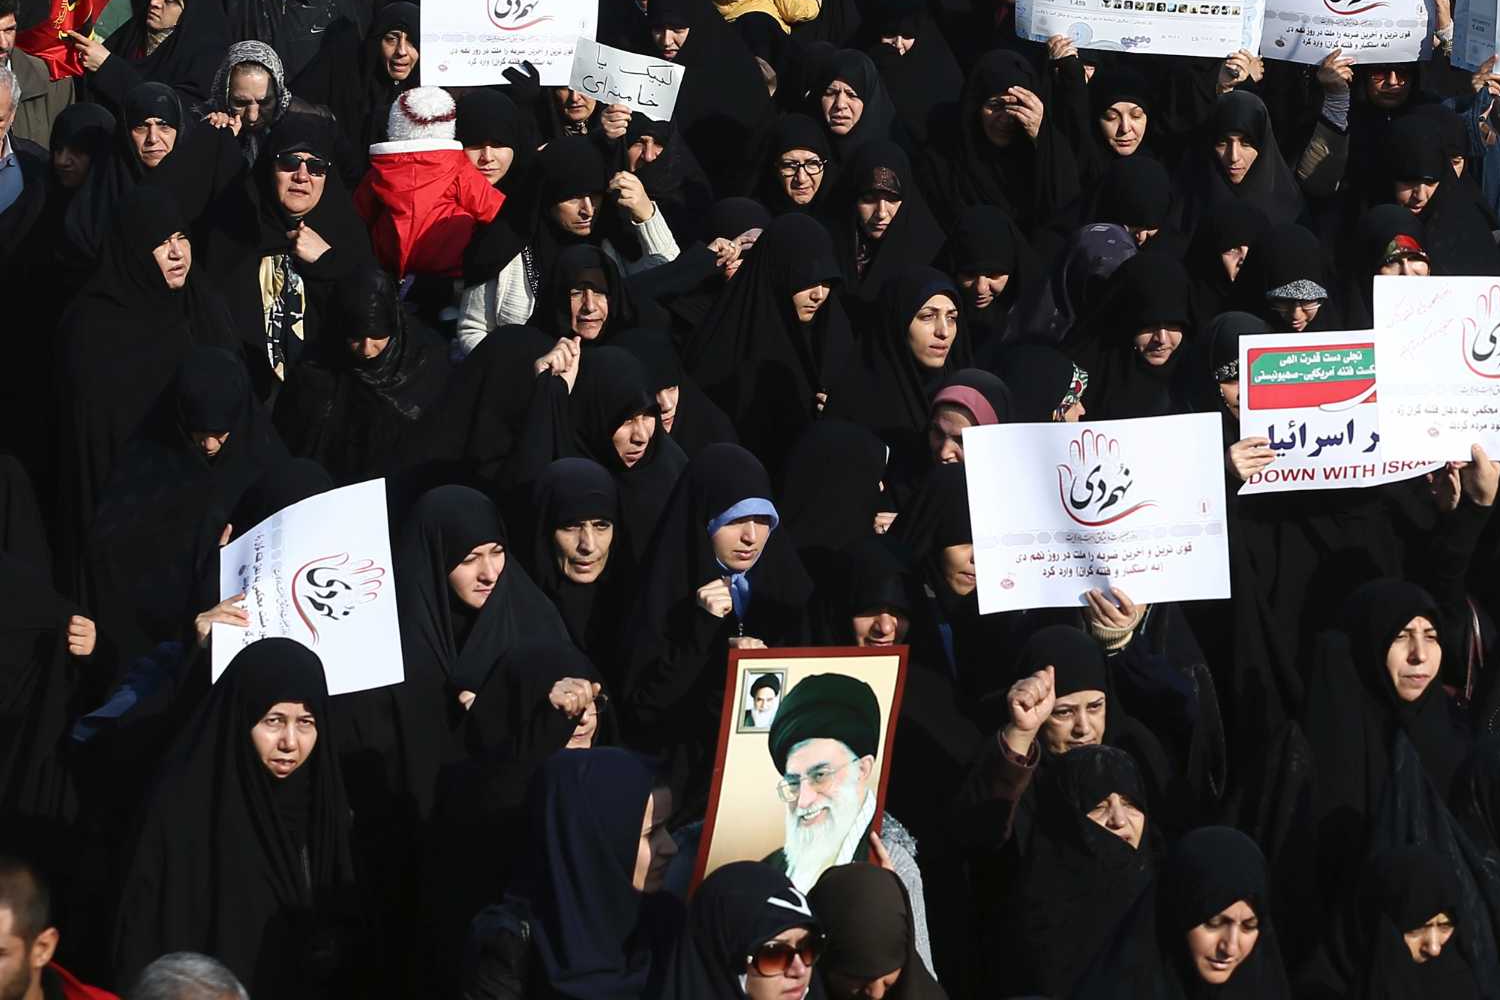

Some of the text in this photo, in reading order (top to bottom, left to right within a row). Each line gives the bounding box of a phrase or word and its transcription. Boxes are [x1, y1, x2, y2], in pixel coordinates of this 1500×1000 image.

[597, 45, 674, 86] لبیک یا
[1249, 464, 1375, 484] DOWN WITH
